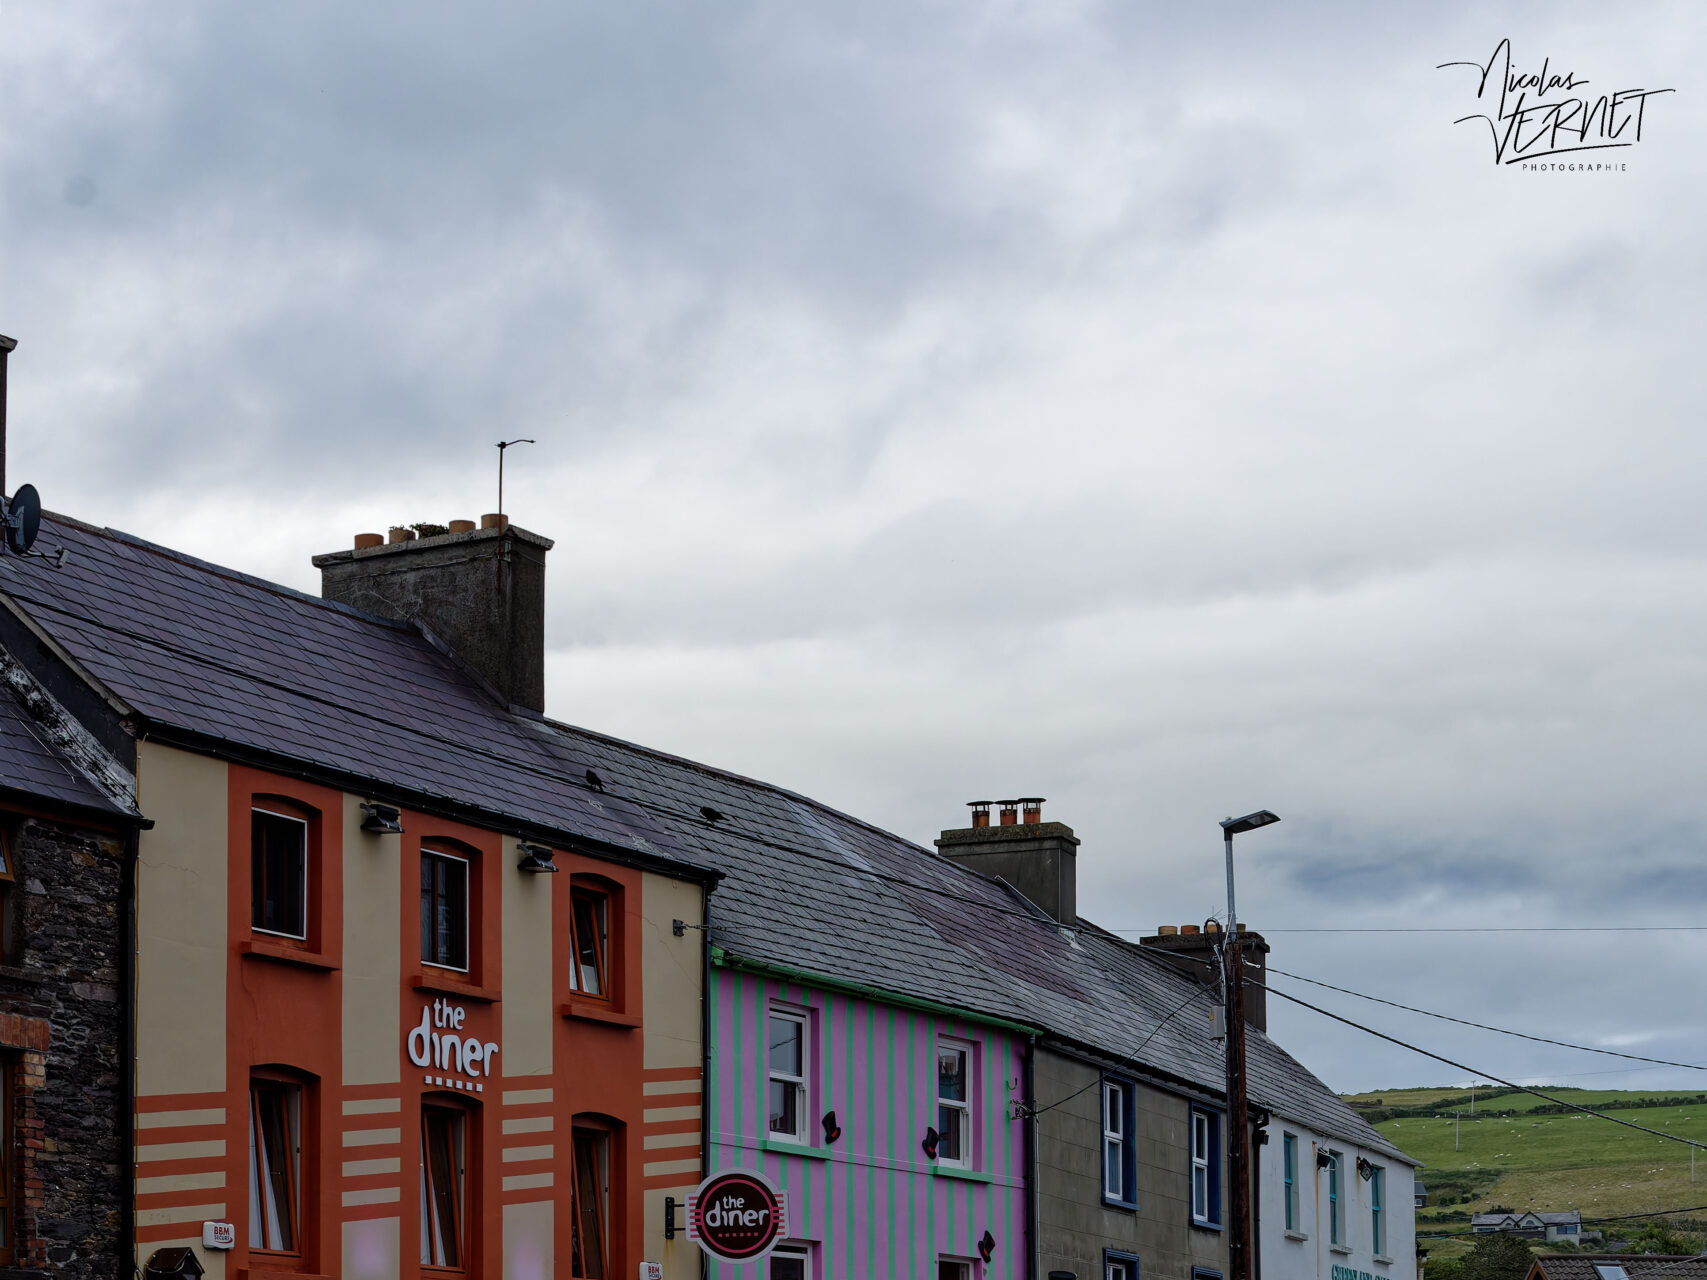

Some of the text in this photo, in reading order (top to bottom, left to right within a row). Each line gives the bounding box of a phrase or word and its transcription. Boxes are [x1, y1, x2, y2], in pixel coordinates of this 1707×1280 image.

[433, 997, 466, 1030] the
[408, 1004, 499, 1077] diner
[705, 1200, 770, 1228] diner
[722, 1195, 745, 1210] the
